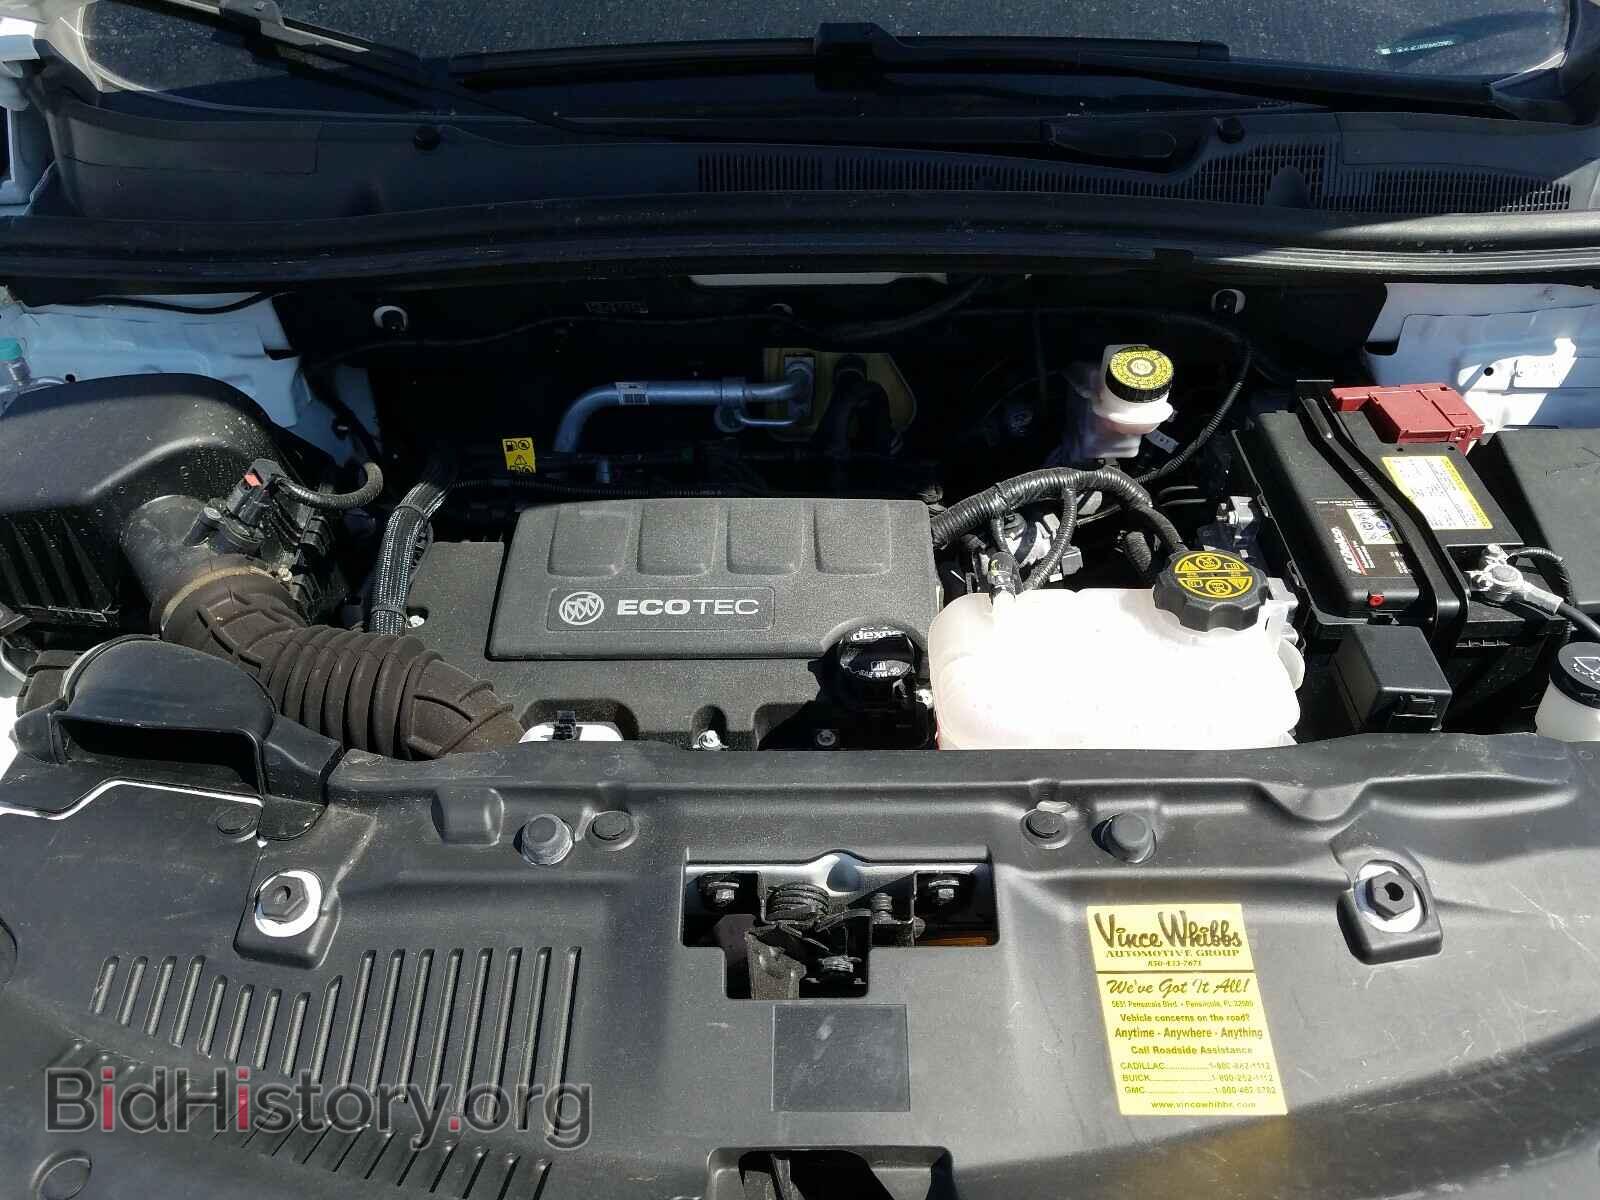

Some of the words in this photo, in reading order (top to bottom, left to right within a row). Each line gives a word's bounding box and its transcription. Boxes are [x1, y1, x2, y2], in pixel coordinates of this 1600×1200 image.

[616, 599, 760, 616] ECOTEC
[1094, 912, 1163, 948] Vince
[1158, 910, 1243, 948] Whibbs
[1105, 949, 1192, 958] AUTOMOTIVE
[1196, 949, 1240, 957] GROUP
[1106, 979, 1153, 994] We've
[1158, 978, 1189, 999] Got
[1192, 979, 1210, 994] It
[1213, 978, 1250, 994] All!
[1119, 1013, 1152, 1022] Vehicle
[1209, 1013, 1224, 1022] the
[1226, 1013, 1250, 1022] road?
[1114, 1027, 1155, 1040] Anytime
[1163, 1027, 1213, 1040] Anywhere
[1220, 1027, 1264, 1040] Anything
[1130, 1046, 1150, 1055] Call
[1153, 1046, 1197, 1055] Roadside
[1200, 1046, 1254, 1055] Assistance
